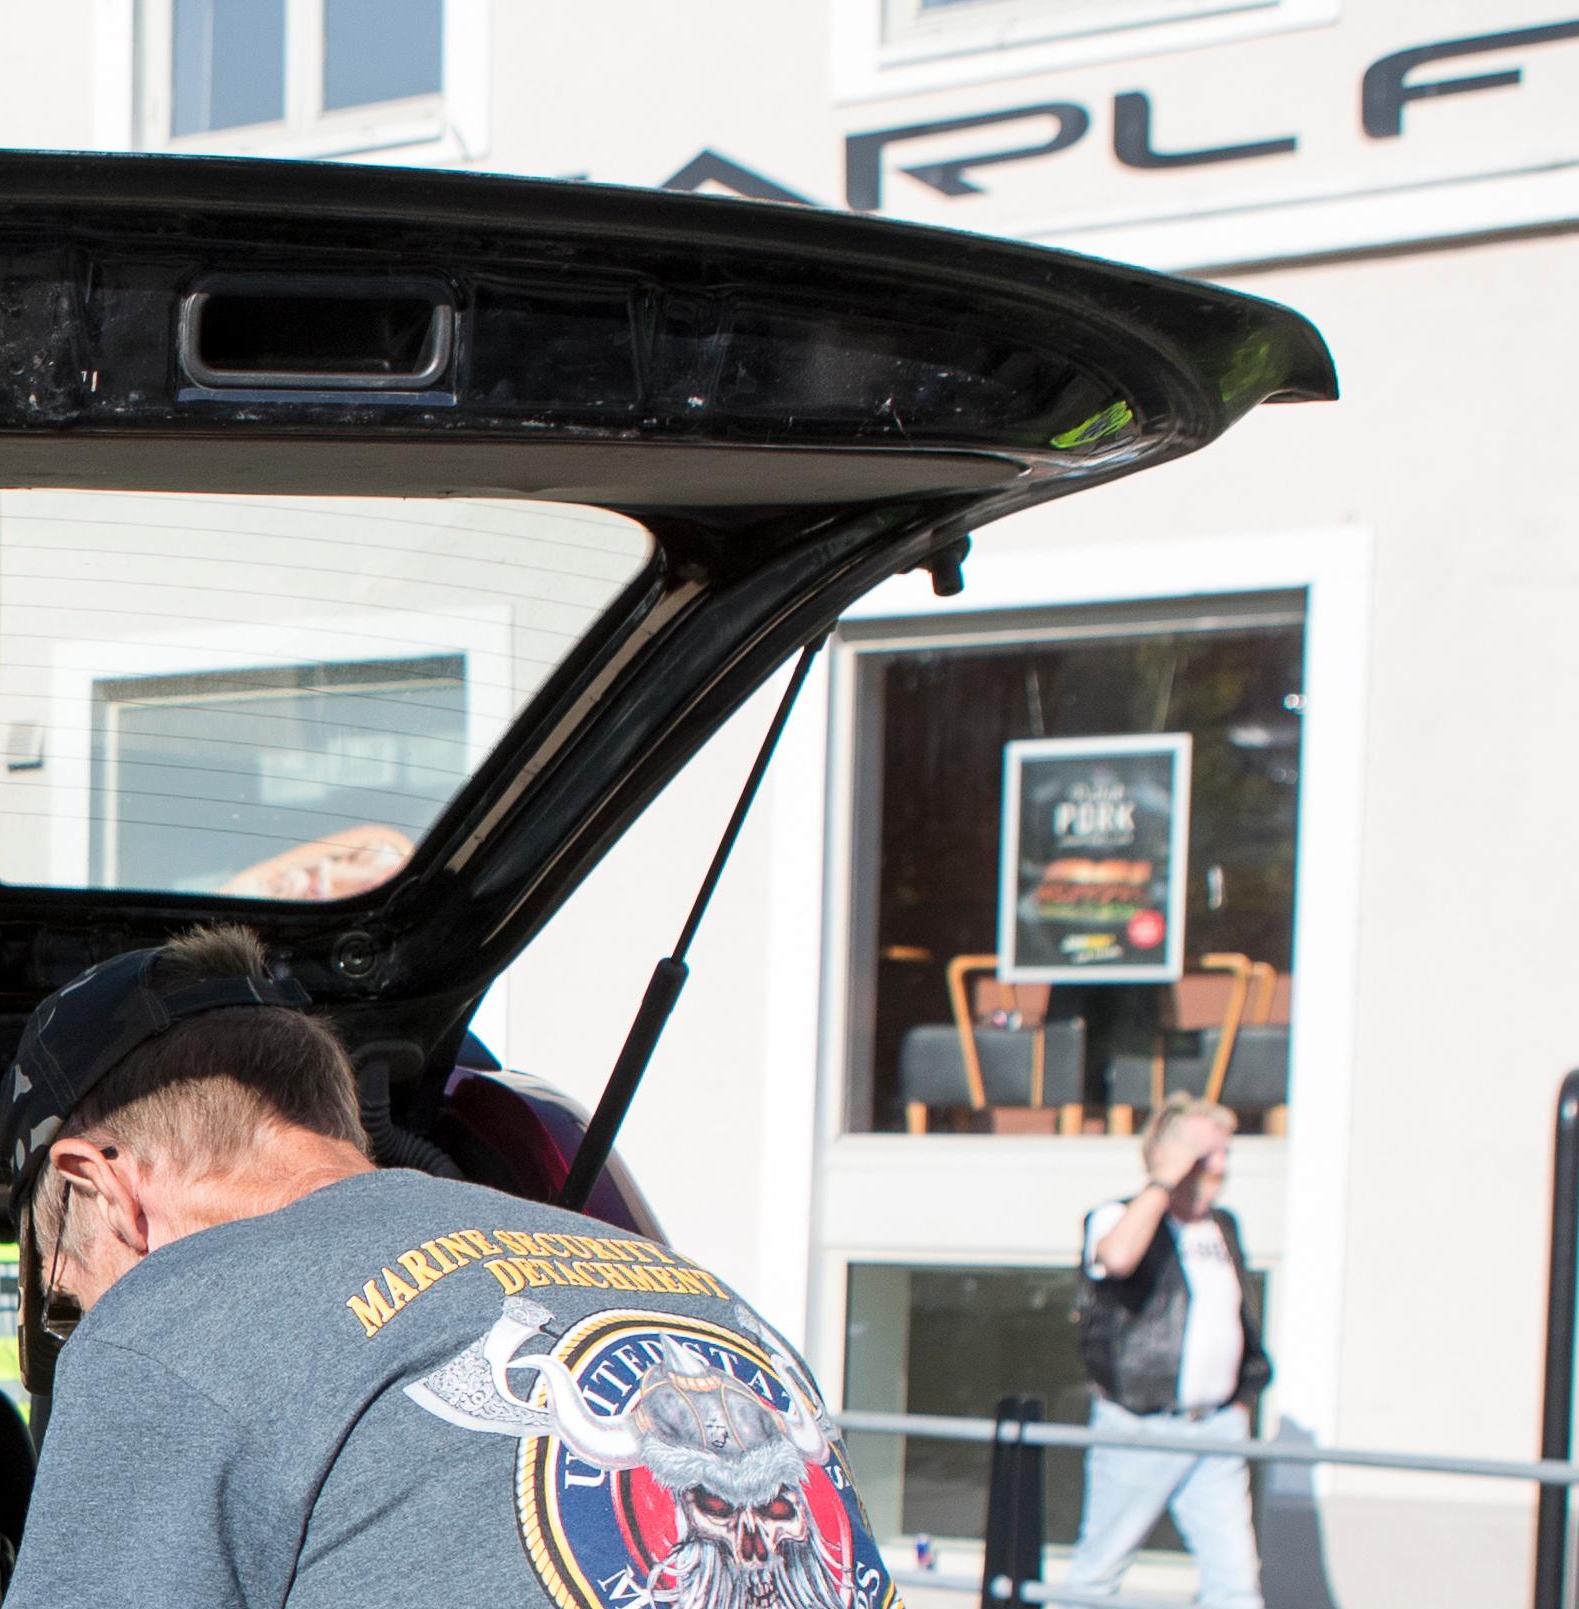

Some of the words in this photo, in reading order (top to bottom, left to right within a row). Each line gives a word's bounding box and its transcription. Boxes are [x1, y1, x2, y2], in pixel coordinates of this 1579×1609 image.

[1053, 801, 1136, 836] PORK
[346, 1228, 503, 1339] MARINE
[492, 1229, 677, 1265] SECURITY
[483, 1257, 732, 1301] DETACHMENT
